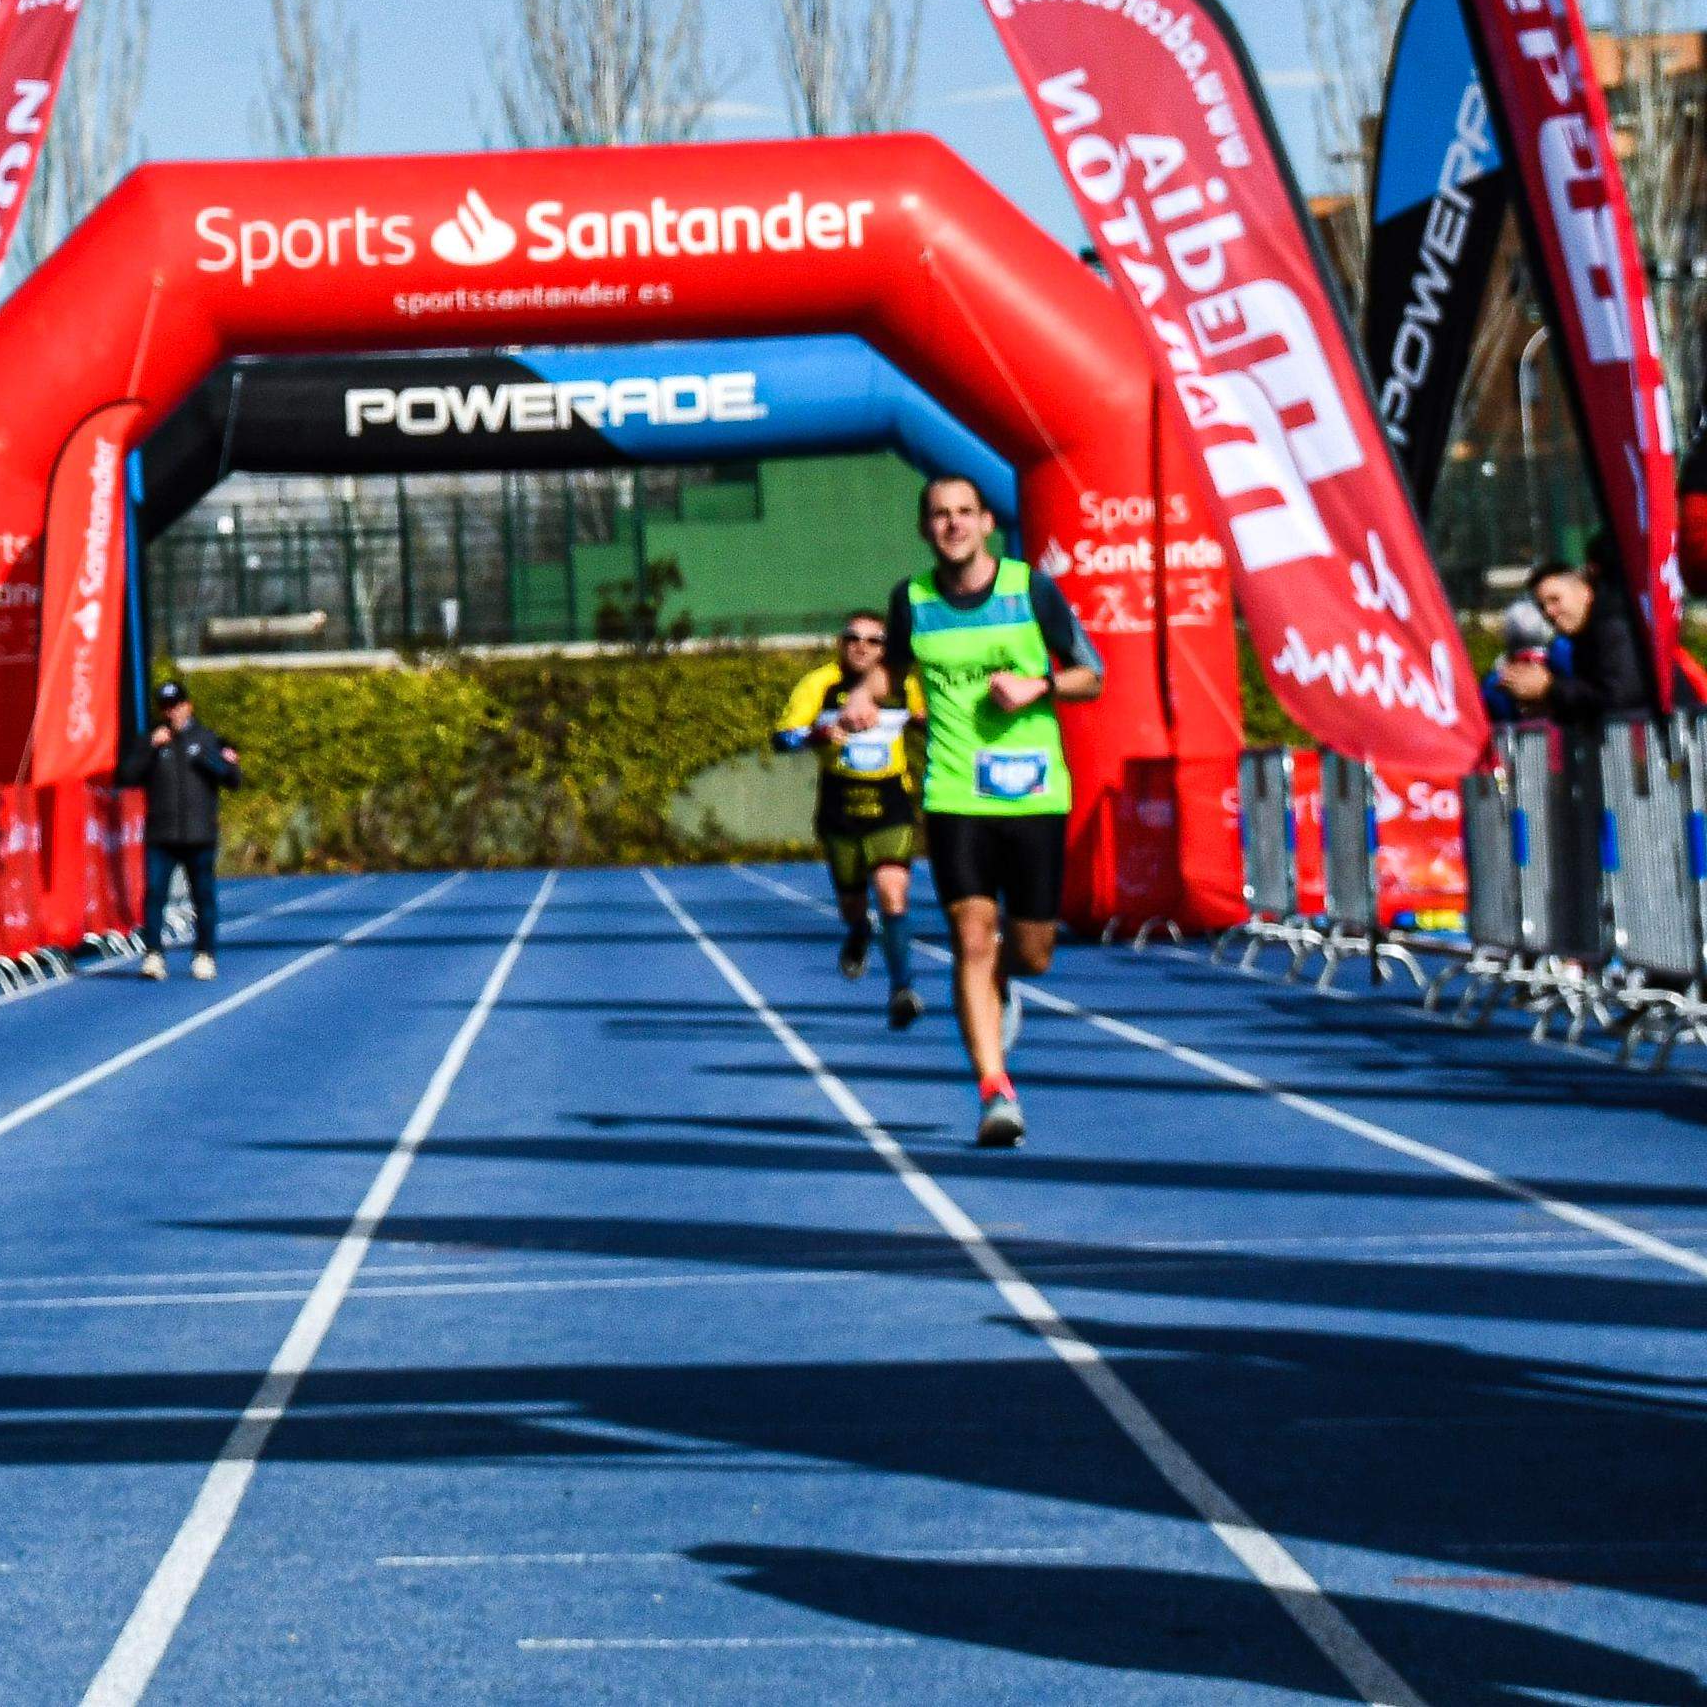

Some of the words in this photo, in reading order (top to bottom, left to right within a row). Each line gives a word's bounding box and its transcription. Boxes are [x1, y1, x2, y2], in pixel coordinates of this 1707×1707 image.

[195, 206, 416, 287] Sports
[526, 192, 876, 262] Santander
[344, 371, 770, 439] POWERADE
